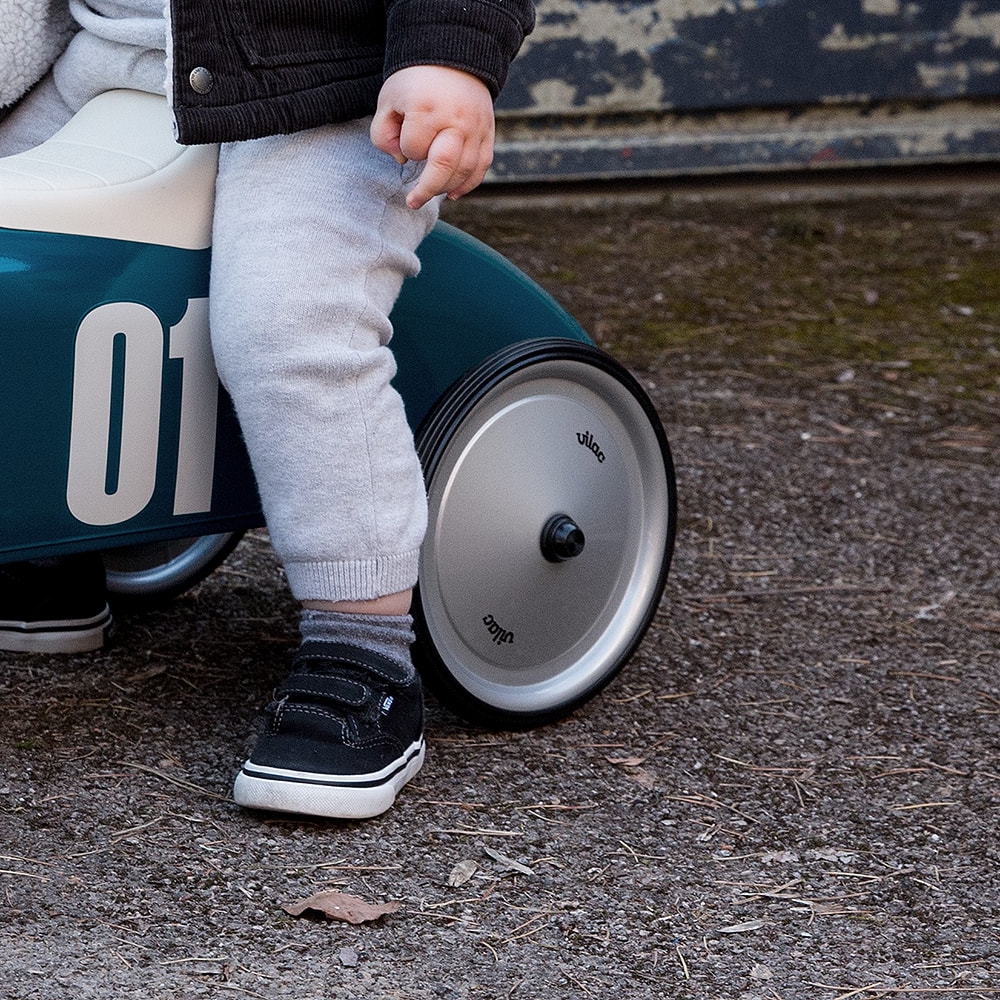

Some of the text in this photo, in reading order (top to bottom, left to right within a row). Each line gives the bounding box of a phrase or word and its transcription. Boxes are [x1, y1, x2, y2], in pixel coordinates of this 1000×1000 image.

[66, 297, 219, 526] 01
[576, 430, 606, 464] vilac
[482, 614, 515, 646] vilac
